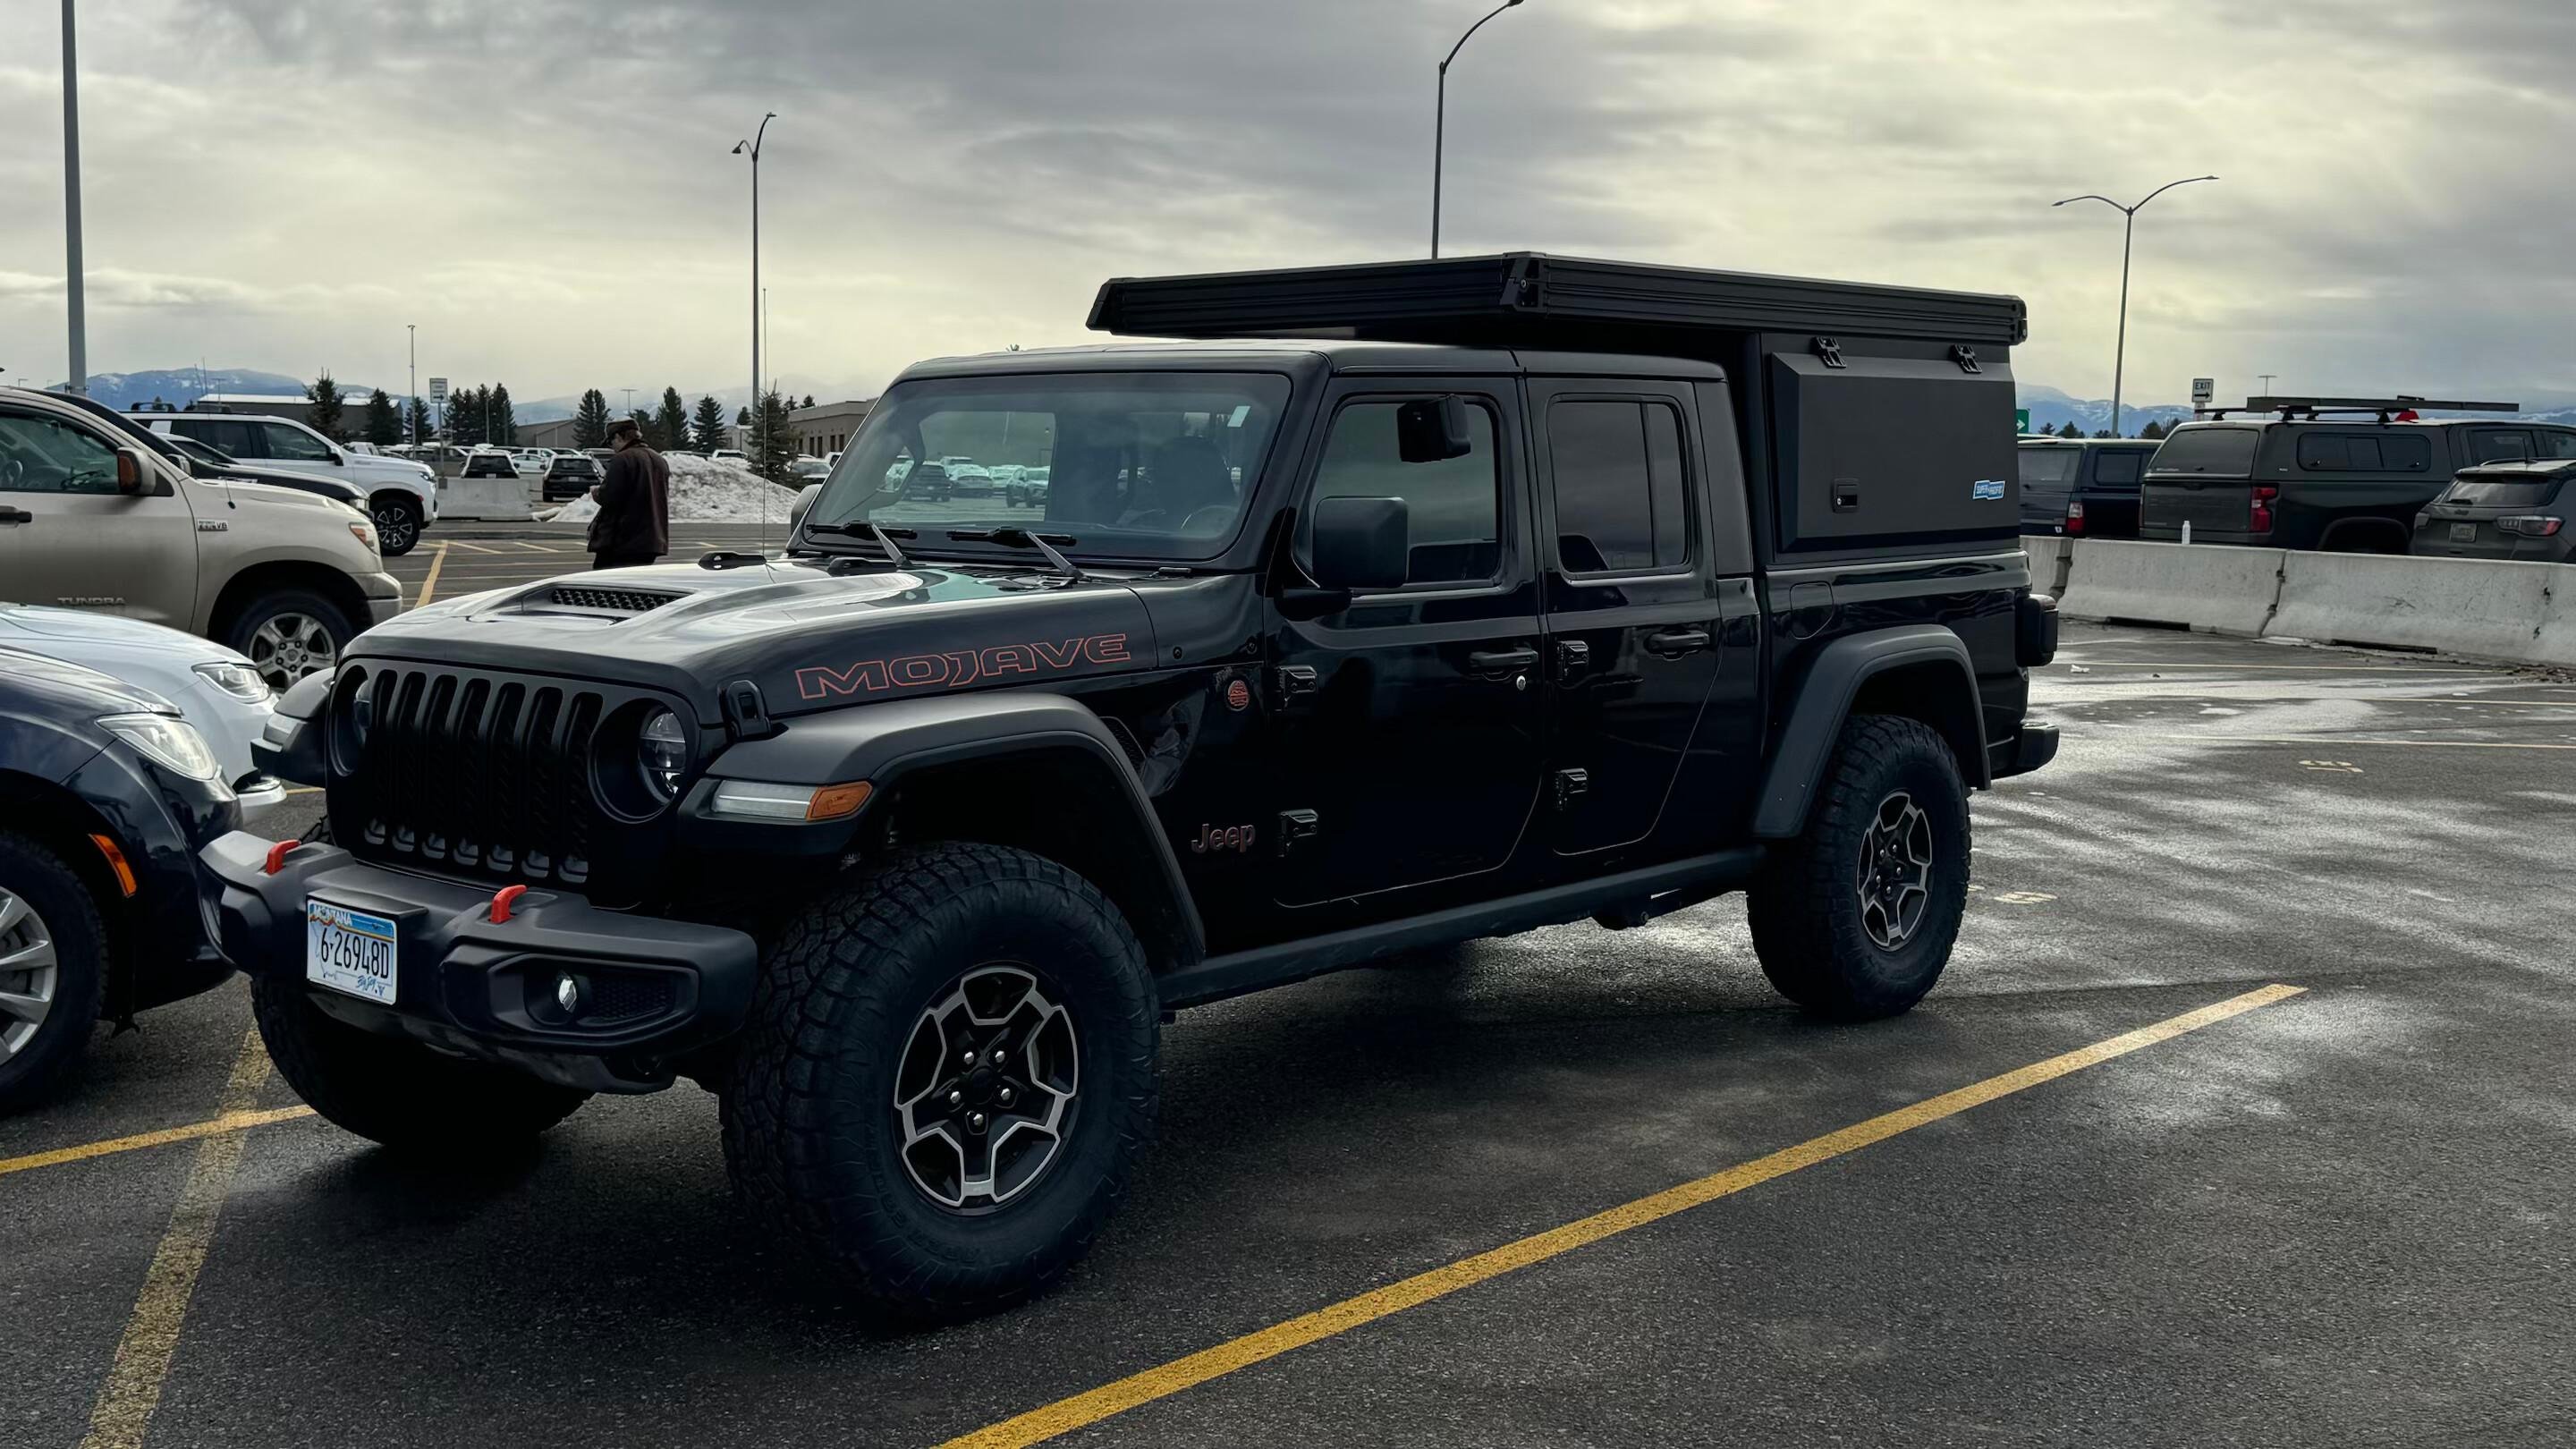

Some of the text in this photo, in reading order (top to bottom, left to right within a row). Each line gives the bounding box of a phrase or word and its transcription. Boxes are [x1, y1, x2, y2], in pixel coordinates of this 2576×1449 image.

[2195, 382, 2211, 390] EXIT
[57, 597, 126, 606] TUNDRA
[795, 634, 1131, 699] MOJAVE
[1191, 823, 1256, 852] Jeep
